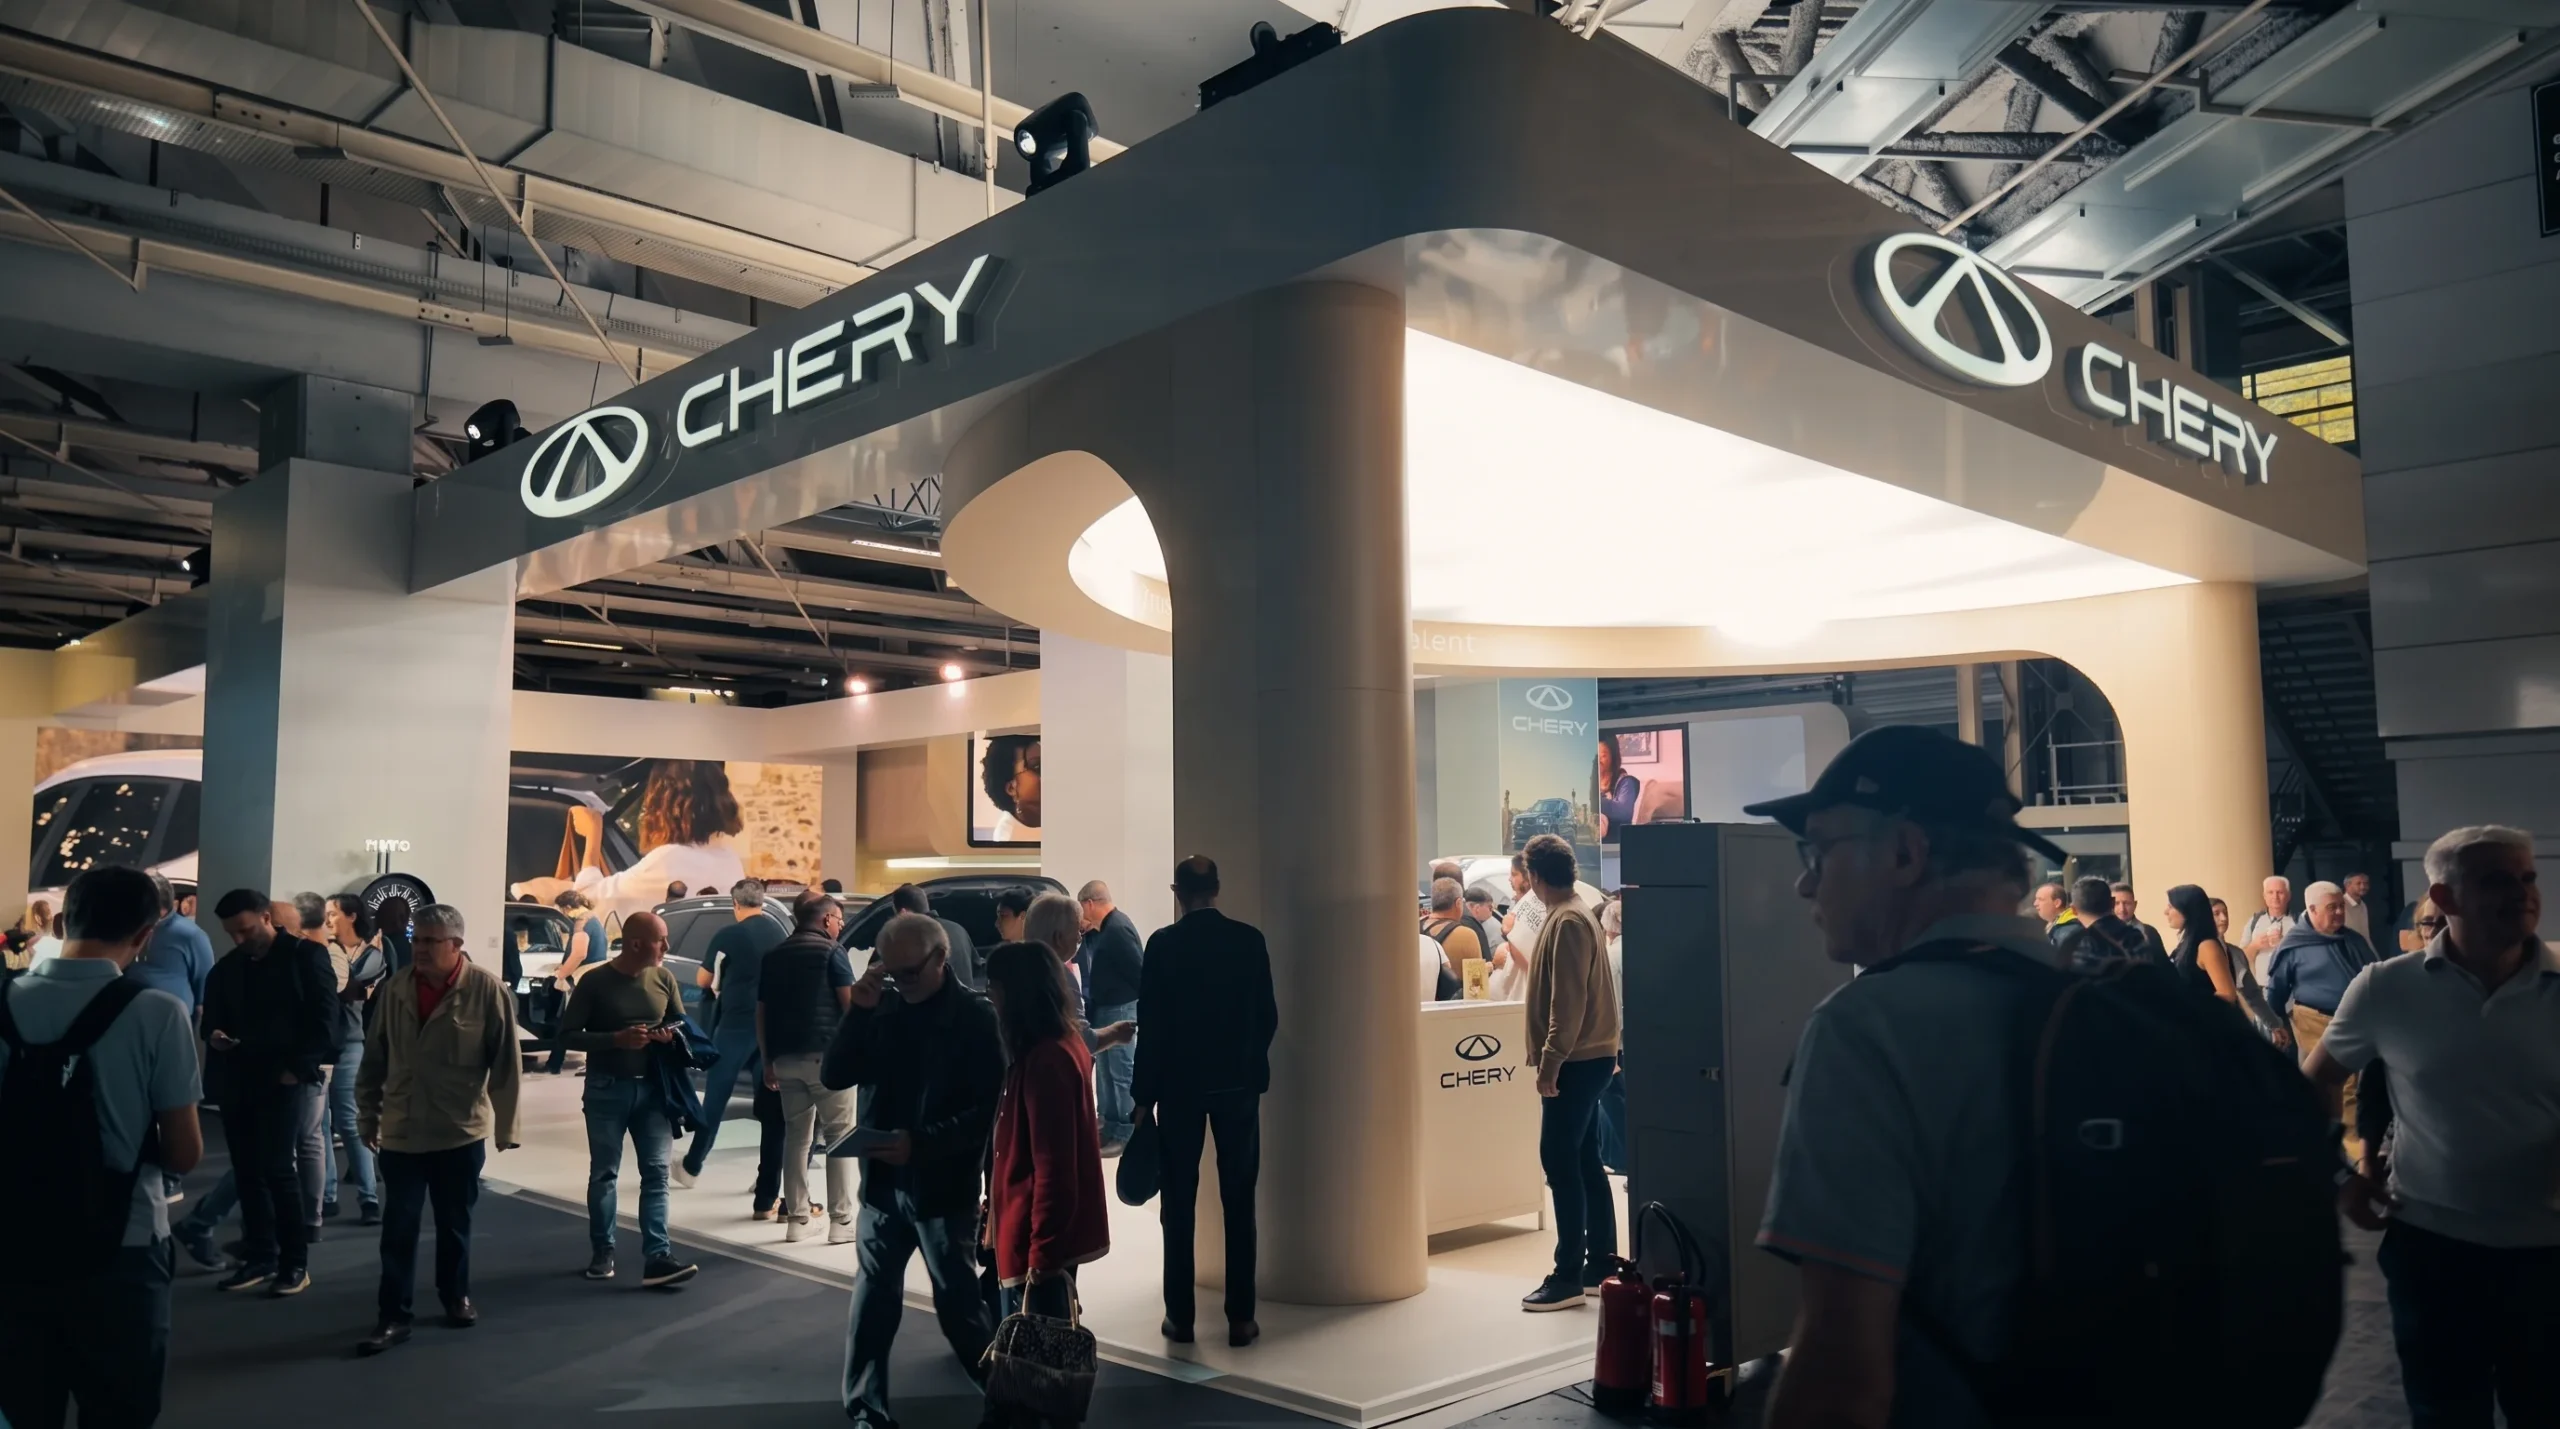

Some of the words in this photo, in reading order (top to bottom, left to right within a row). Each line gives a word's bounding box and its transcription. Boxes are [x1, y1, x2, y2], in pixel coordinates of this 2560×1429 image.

[677, 253, 990, 448] CHERY
[2081, 341, 2279, 484] CHERY
[1512, 716, 1589, 737] CHERY
[1440, 1065, 1516, 1089] CHERY
